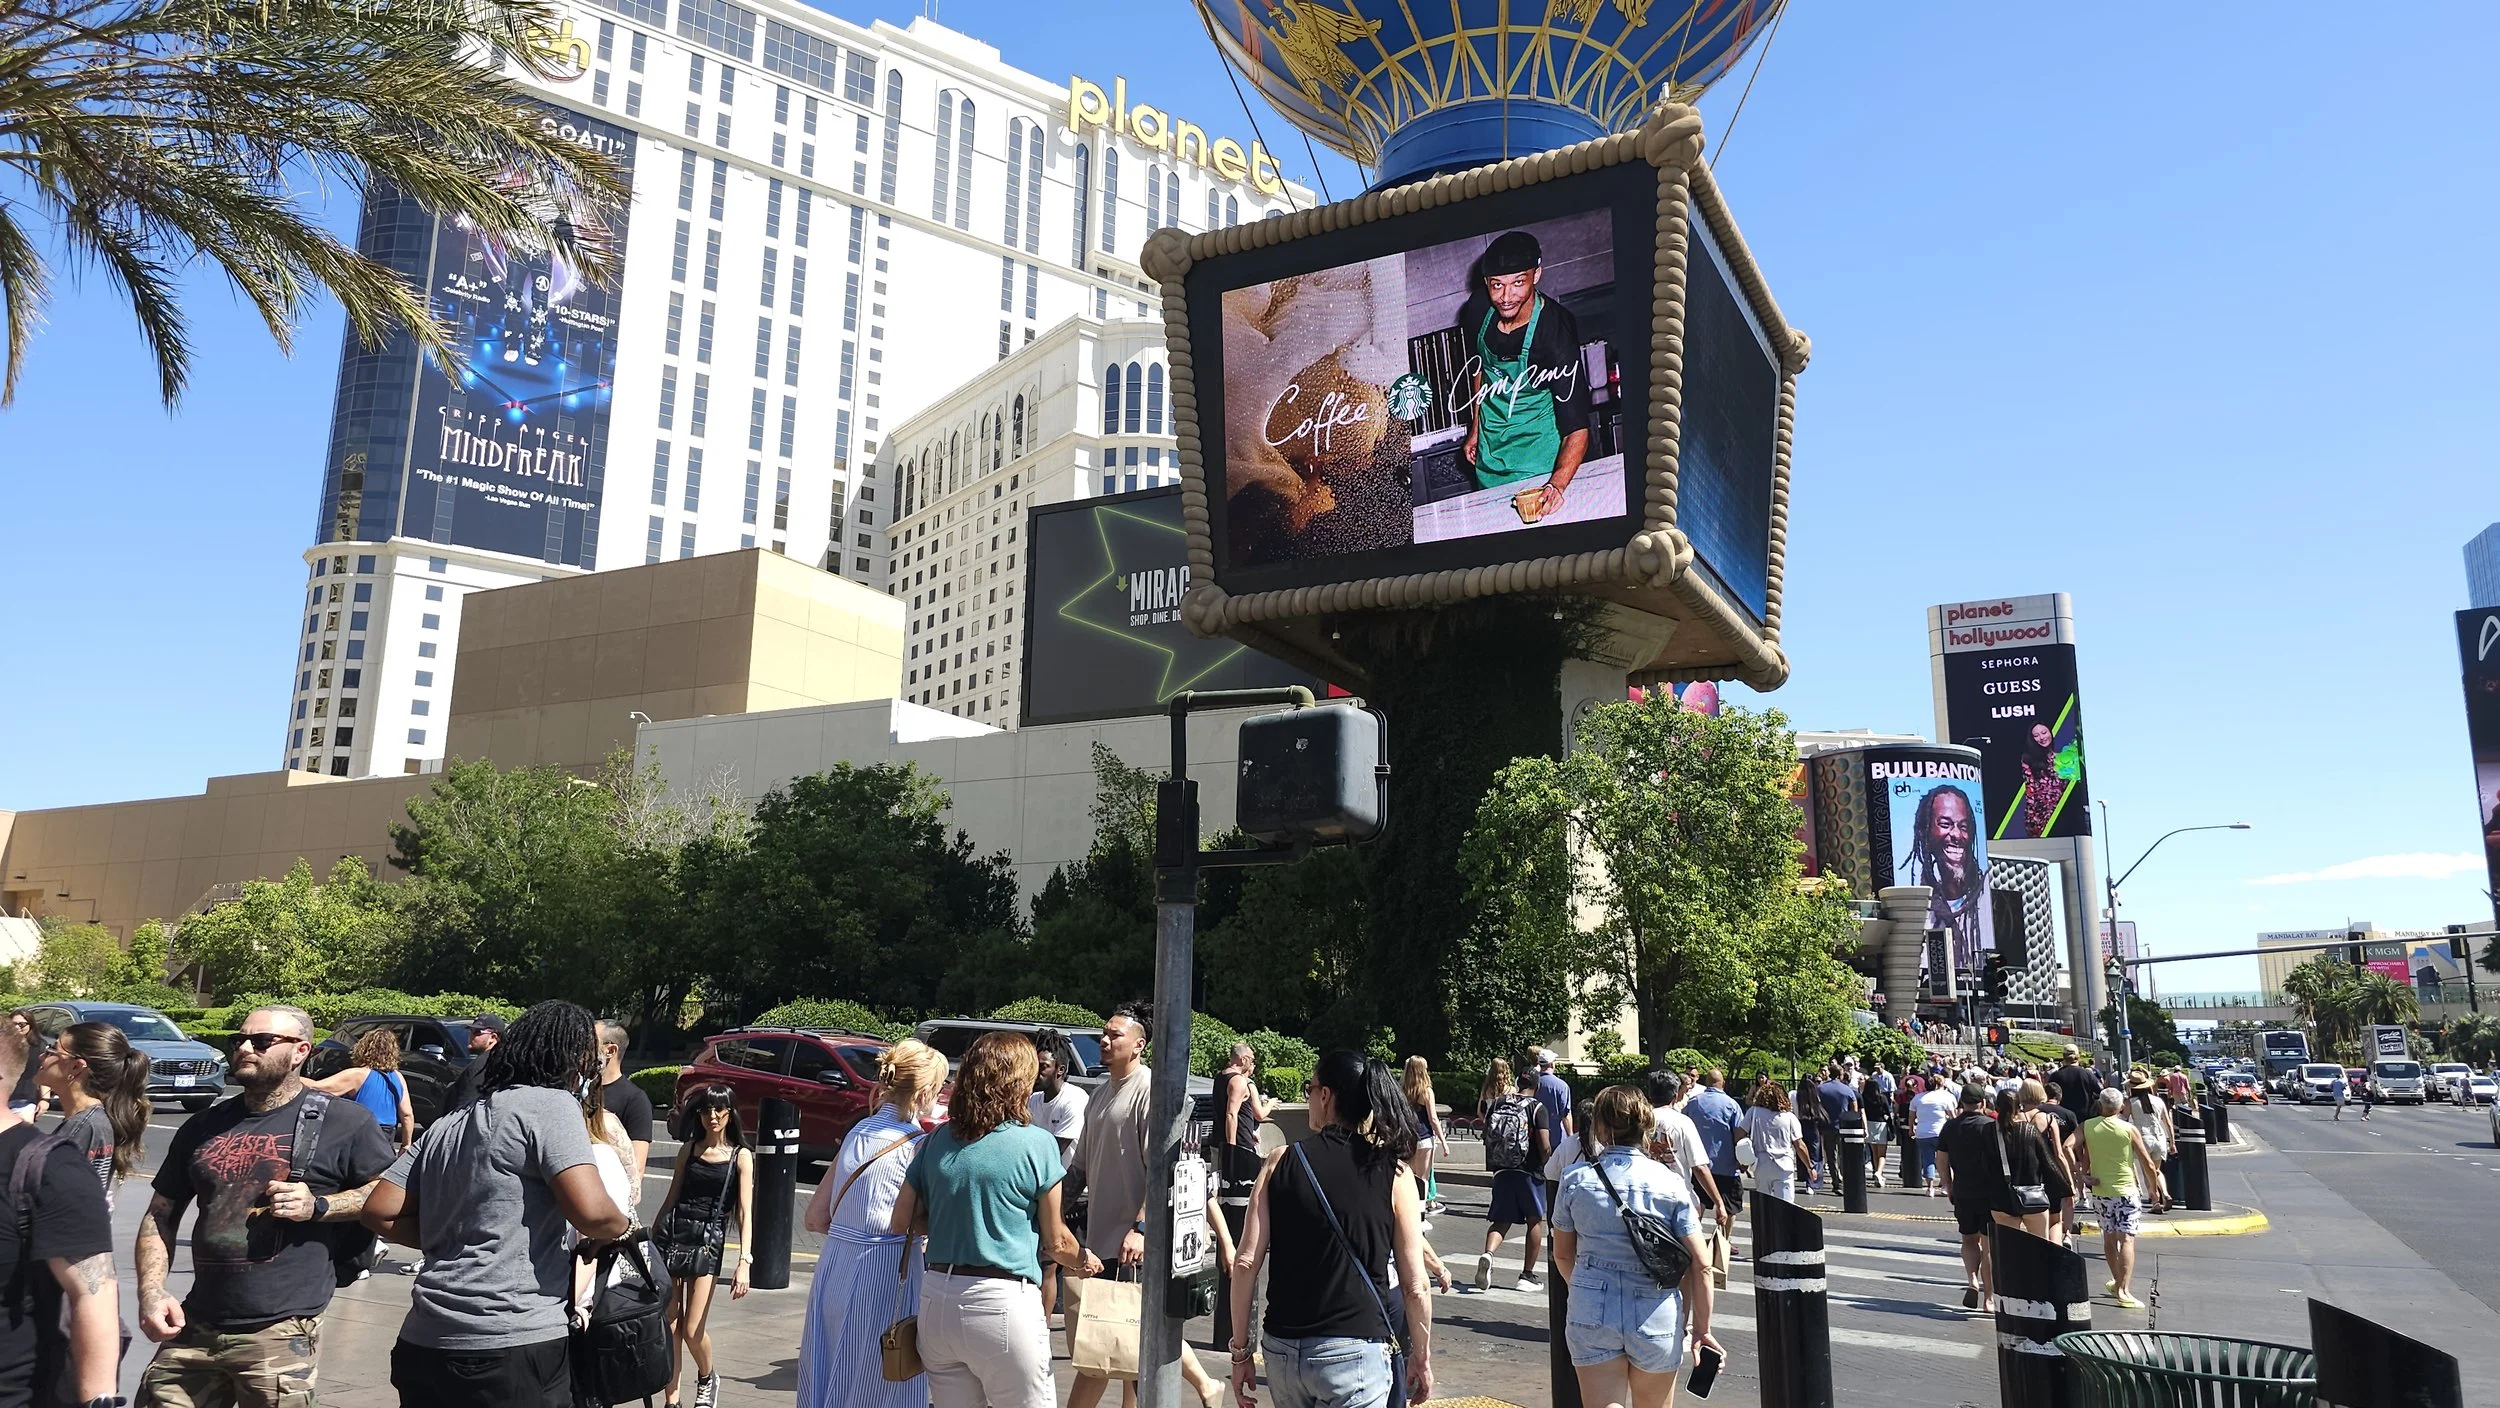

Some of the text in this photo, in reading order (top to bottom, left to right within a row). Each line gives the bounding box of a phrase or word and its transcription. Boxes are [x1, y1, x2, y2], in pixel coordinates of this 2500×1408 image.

[1069, 73, 1282, 195] planet
[1263, 354, 1579, 457] Coffee Company
[438, 405, 590, 451] CRISS ANGEL
[445, 474, 459, 486] #1
[461, 476, 496, 492] Magic
[496, 484, 529, 499] Show
[529, 490, 544, 502] Of
[544, 494, 560, 506] All
[1130, 613, 1151, 627] SHOP.
[1152, 610, 1171, 624] DINE.
[1947, 601, 2014, 626] planet
[1949, 622, 2050, 647] hollywood
[1981, 656, 2039, 670] SEPHORA
[1983, 678, 2041, 695] GUESS
[1991, 704, 2036, 719] LUSH
[1871, 761, 1982, 784] BUJU BANTON
[1895, 781, 1912, 797] ph
[1873, 777, 1894, 886] AS VEGAS
[2267, 932, 2304, 940] MANDALAY
[2375, 947, 2401, 956] MGM
